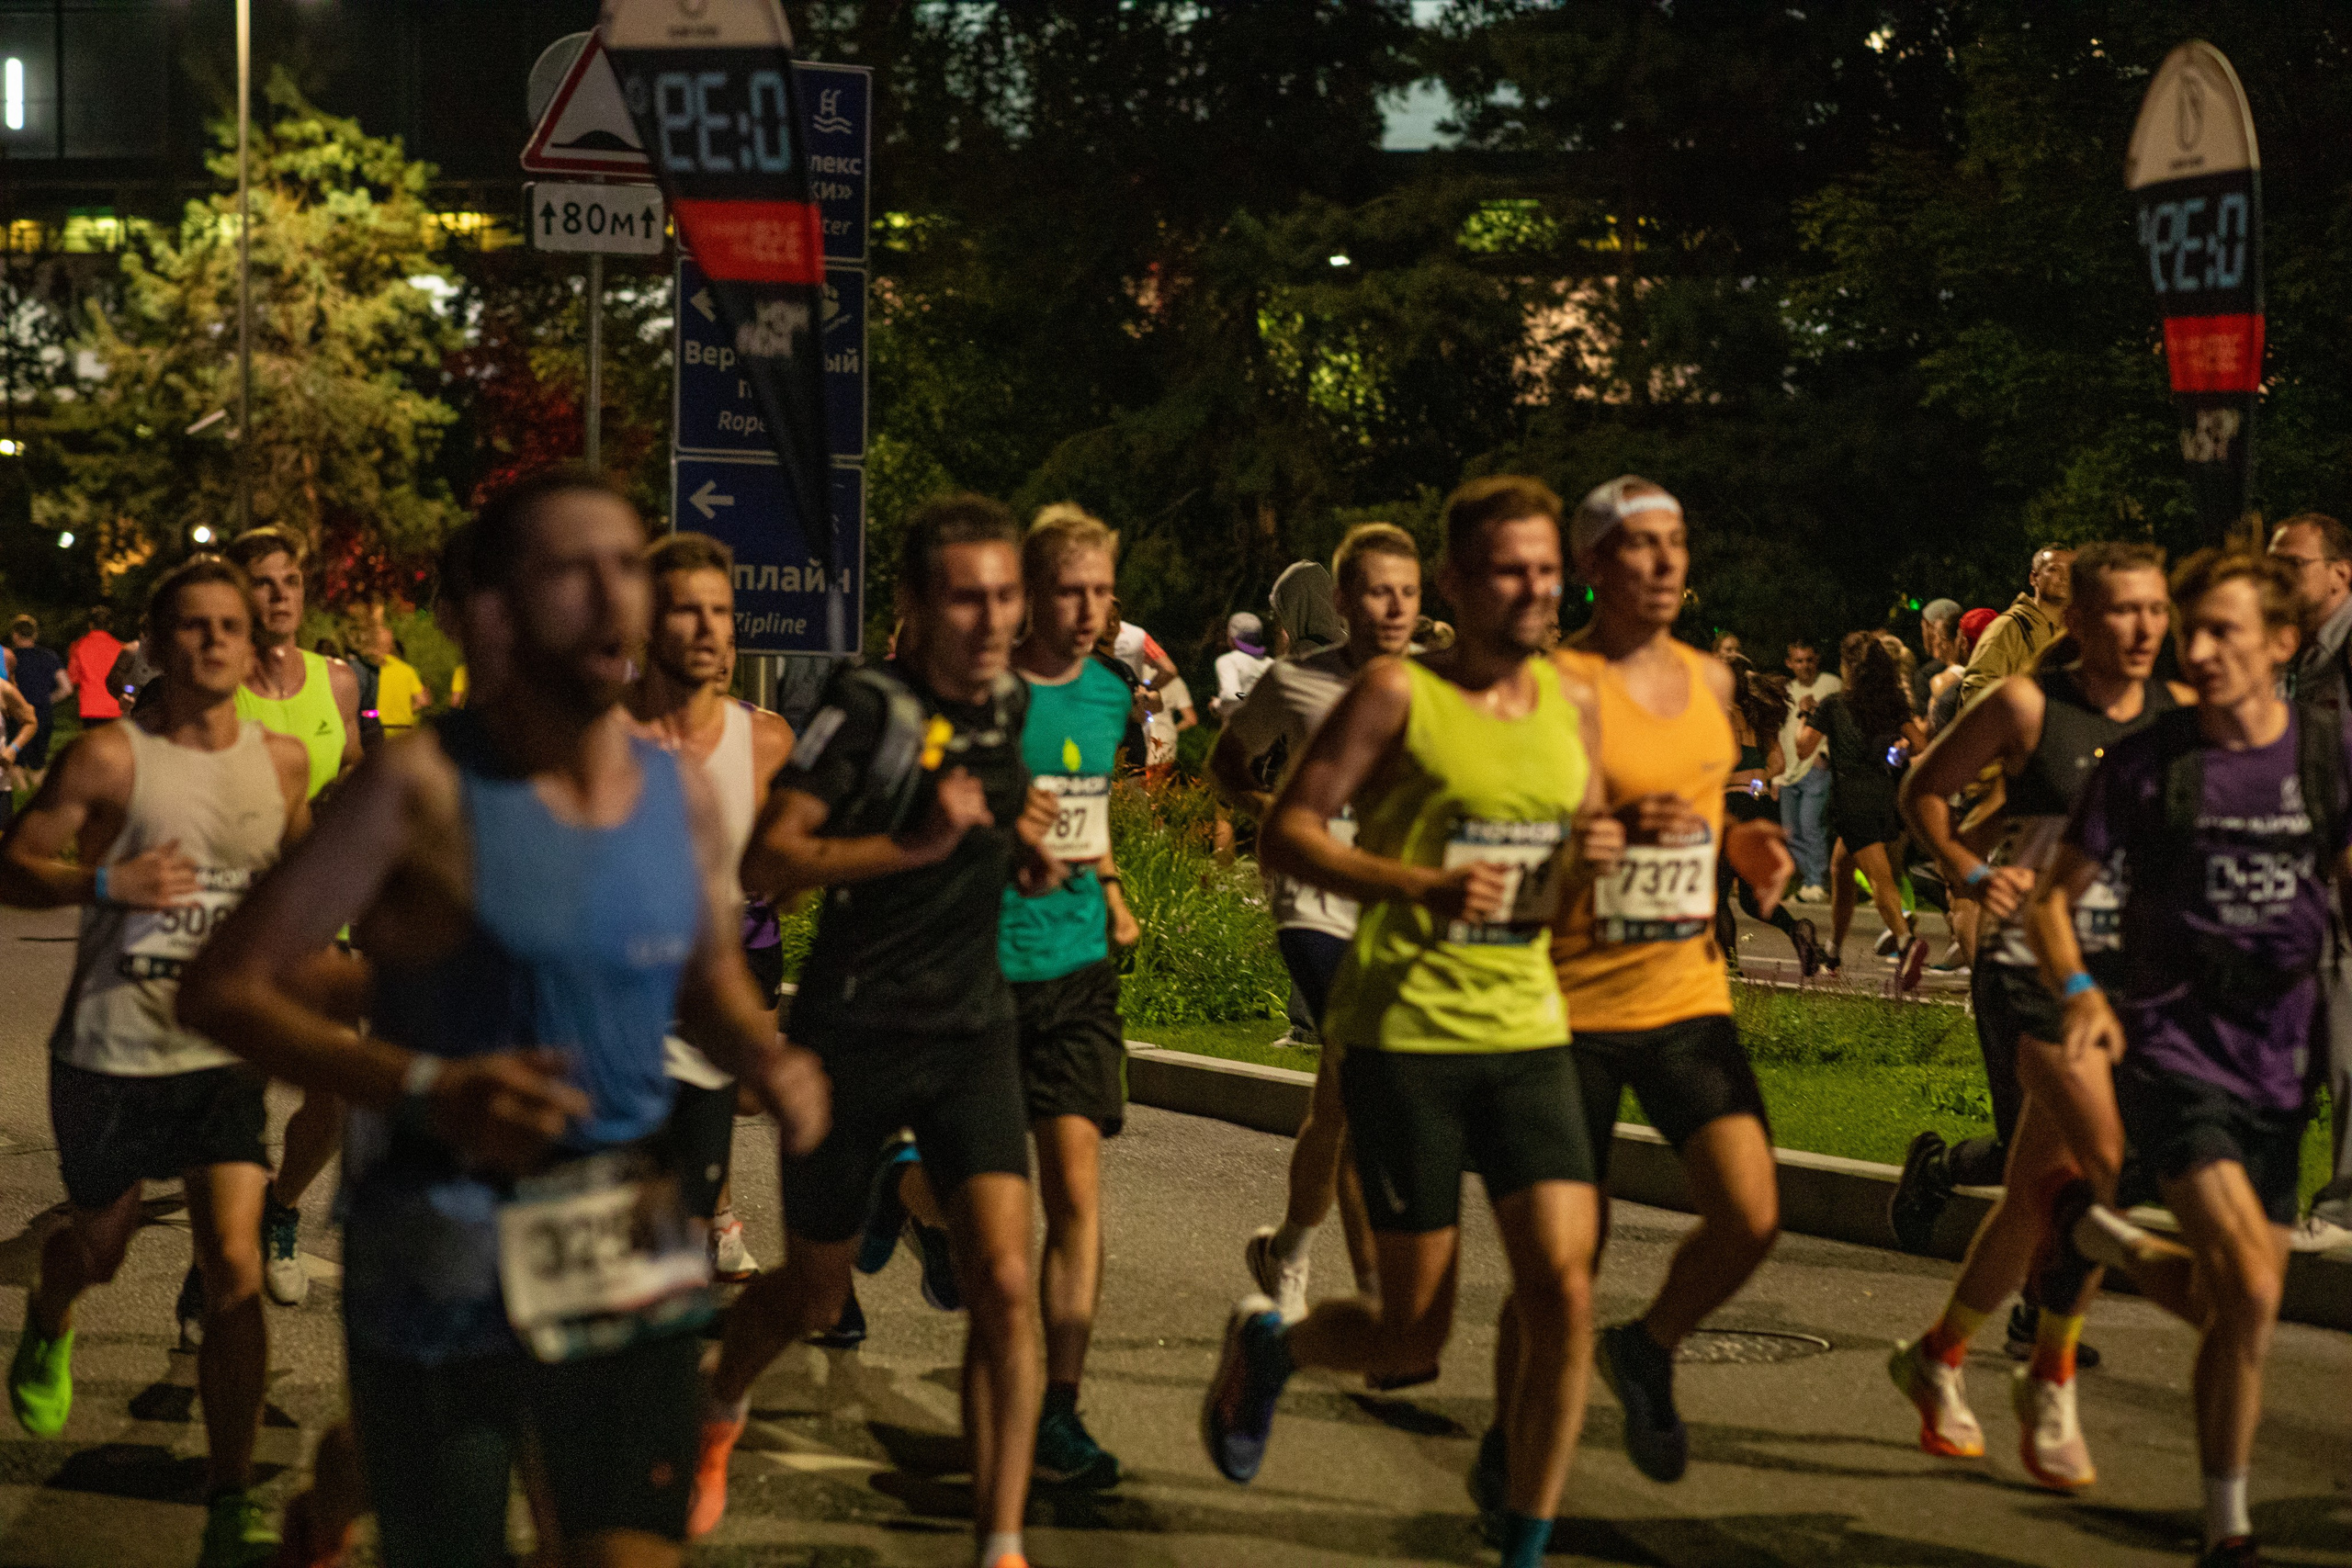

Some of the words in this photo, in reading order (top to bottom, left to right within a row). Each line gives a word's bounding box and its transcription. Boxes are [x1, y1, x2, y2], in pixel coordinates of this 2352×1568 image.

[809, 154, 863, 175] лекс
[822, 218, 854, 236] ter
[1619, 859, 1702, 897] 7372
